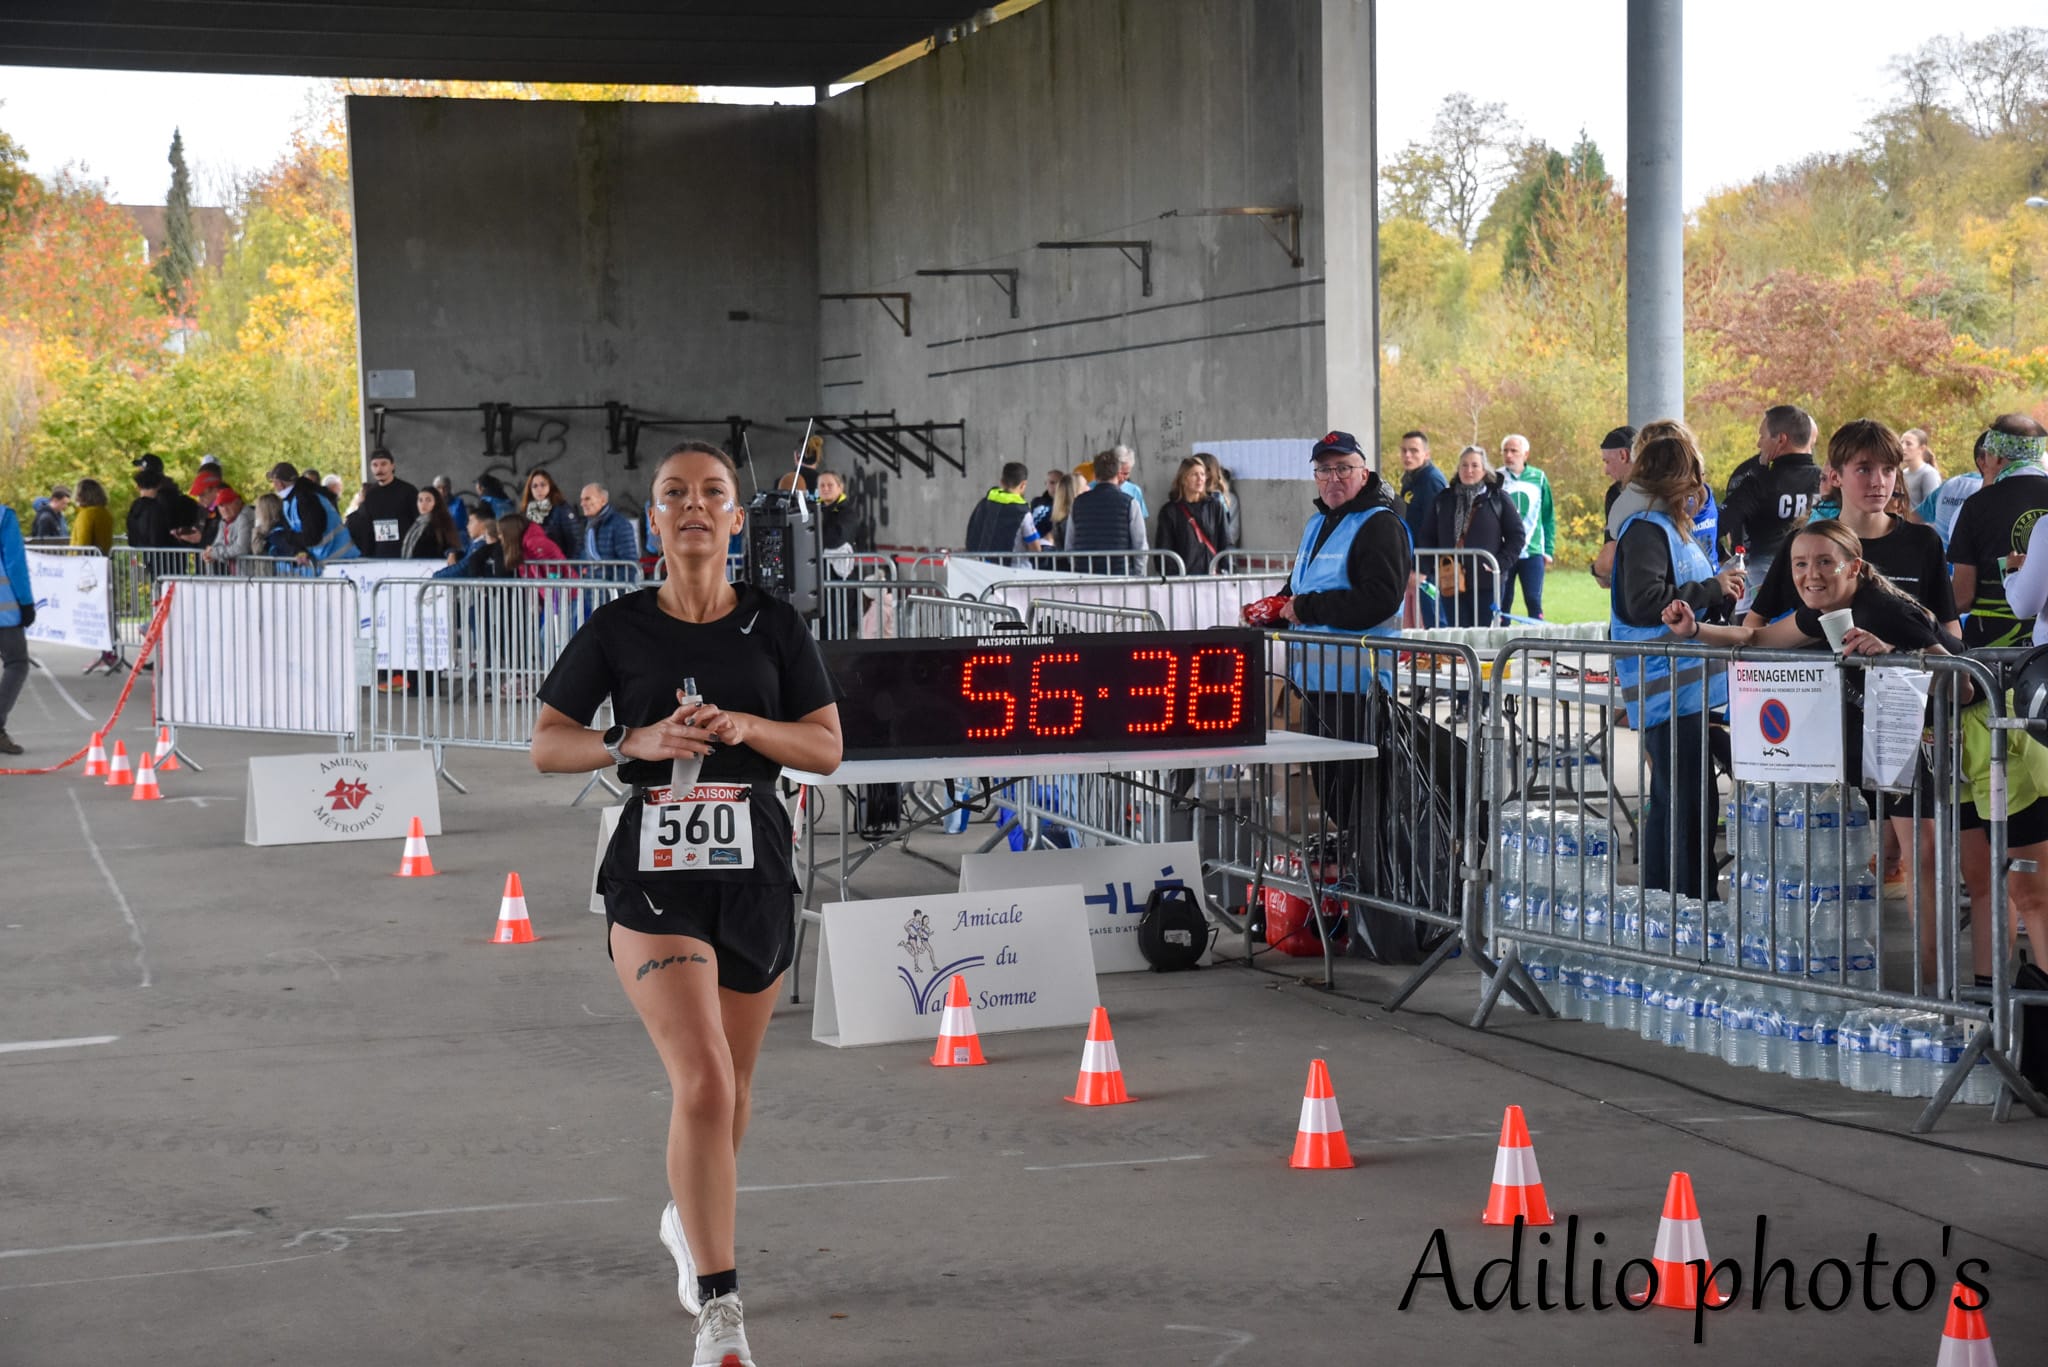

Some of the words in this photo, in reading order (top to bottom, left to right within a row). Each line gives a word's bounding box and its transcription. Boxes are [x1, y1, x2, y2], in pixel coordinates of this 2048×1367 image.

[977, 637, 1020, 647] MATSPORT
[1022, 636, 1054, 646] TIMING
[1737, 669, 1825, 683] DEMENAGEMENT
[320, 756, 369, 774] AMIENS
[651, 791, 672, 803] LES
[687, 788, 741, 801] SAISONS
[313, 803, 384, 833] MÉTROPOLE
[658, 804, 735, 846] 560
[952, 904, 1023, 931] Amicale
[1115, 925, 1139, 934] D'ATH
[996, 945, 1018, 966] du
[976, 990, 1037, 1010] Somme
